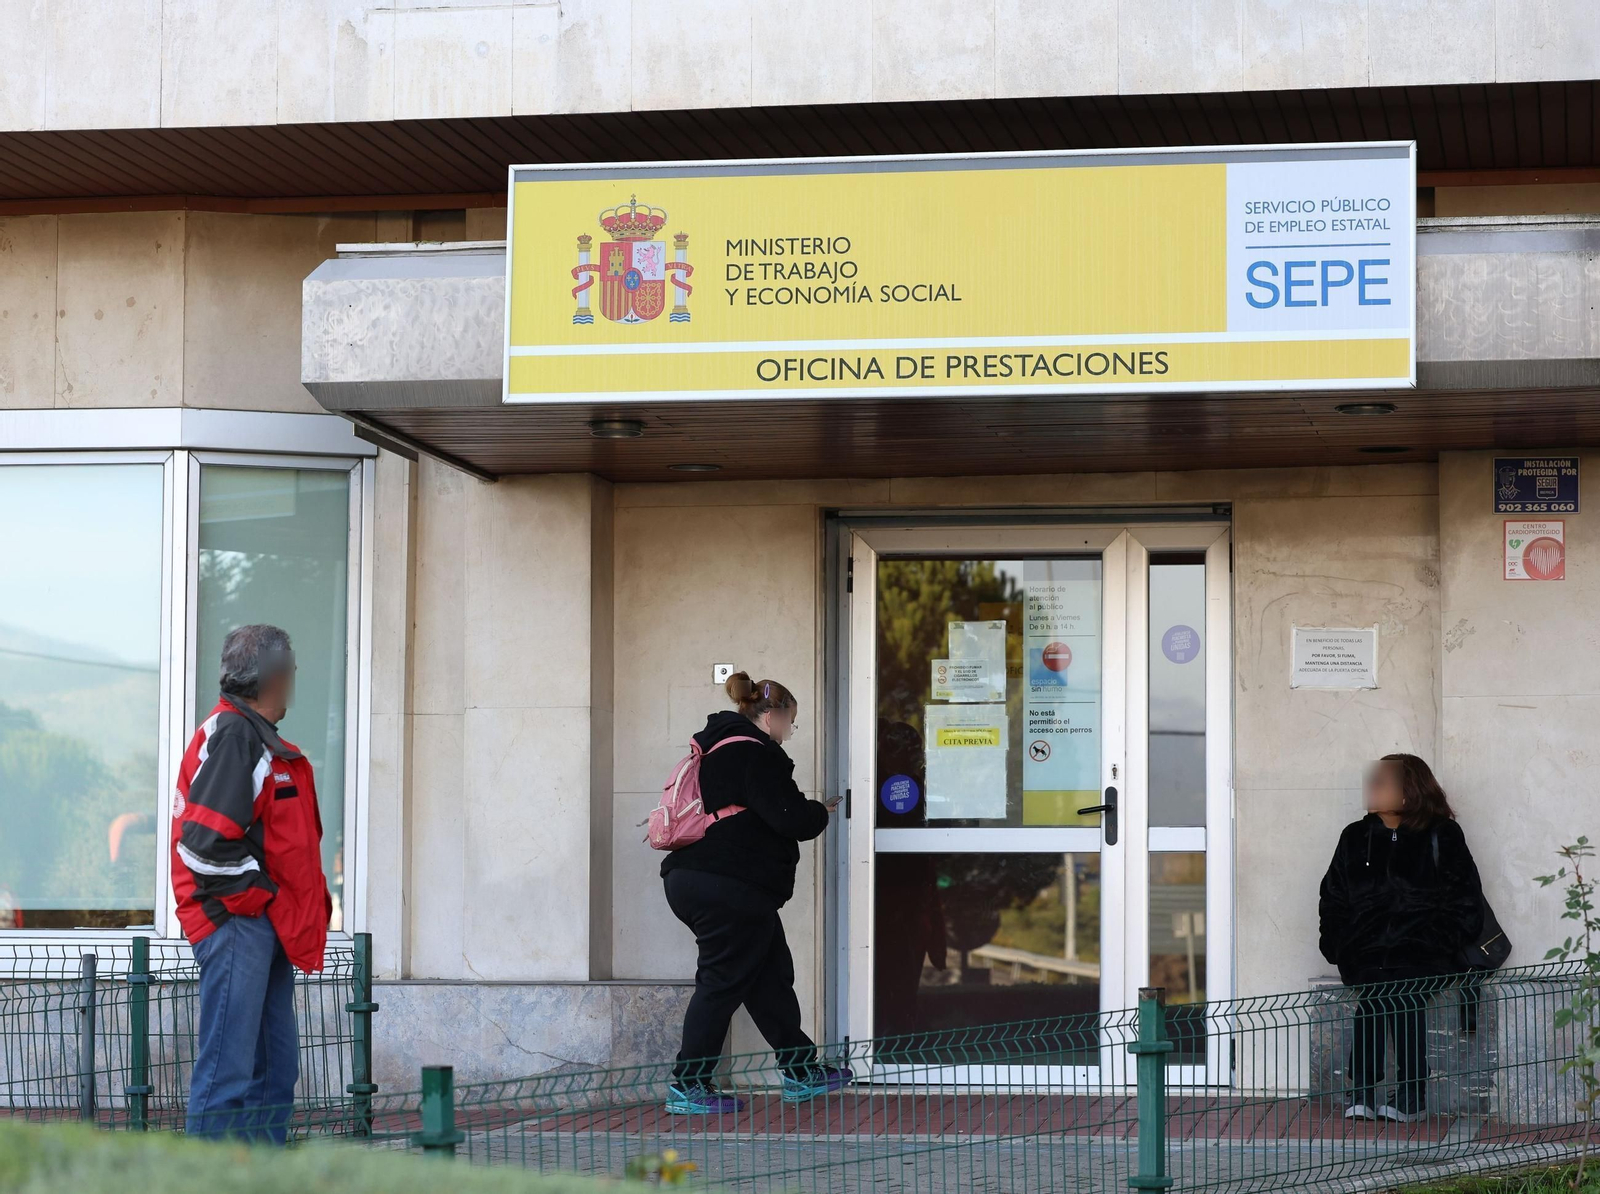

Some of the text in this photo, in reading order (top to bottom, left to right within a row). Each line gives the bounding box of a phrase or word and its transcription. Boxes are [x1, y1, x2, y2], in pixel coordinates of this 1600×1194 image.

[1245, 196, 1391, 215] SERVICIO PÚBLICO
[1245, 218, 1391, 234] DE EMPLEO ESTATAL
[726, 236, 851, 256] MINISTERIO
[726, 261, 858, 284] DE TRABAJO
[1245, 258, 1392, 309] SEPE
[725, 281, 962, 306] Y ECONOMÍA SOCIAL
[756, 351, 1169, 382] OFICINA DE PRESTACIONES
[1524, 459, 1571, 468] INSTALACIÓN
[1517, 468, 1577, 476] PROTEGIDA POR
[1537, 477, 1557, 487] SEGUR
[1498, 503, 1575, 511] 902 365 060
[1029, 585, 1066, 593] Horario de
[1037, 603, 1064, 611] público
[1040, 709, 1055, 717] está
[1029, 718, 1062, 726] permitido
[1069, 727, 1093, 735] perros
